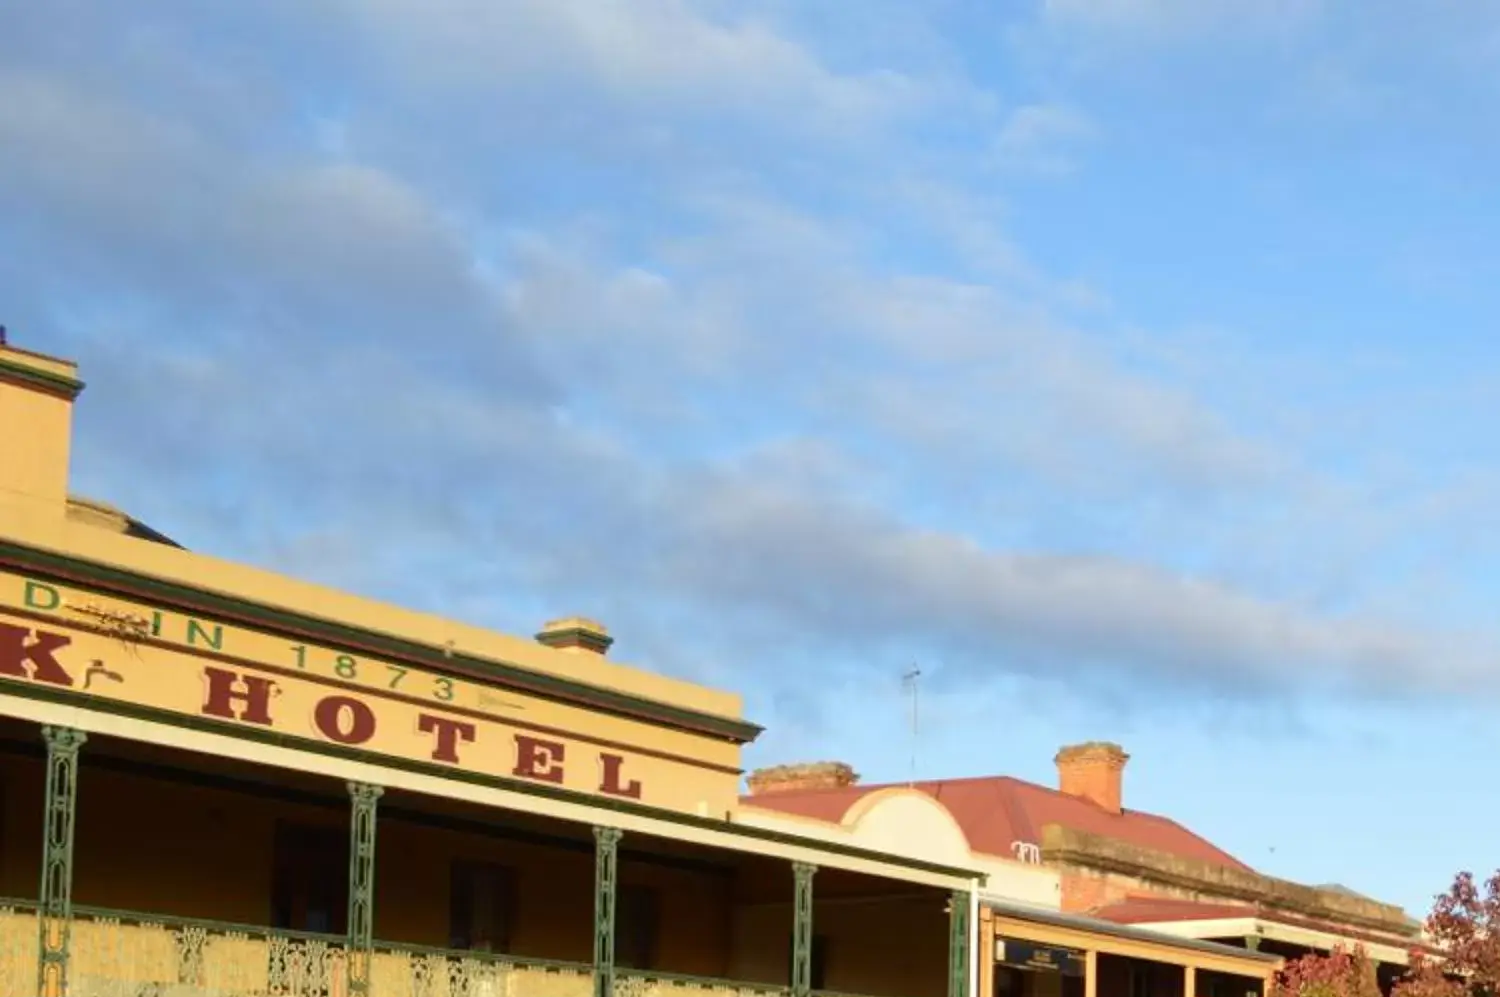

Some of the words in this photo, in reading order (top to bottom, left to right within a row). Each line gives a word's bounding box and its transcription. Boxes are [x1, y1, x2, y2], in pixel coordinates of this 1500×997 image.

[0, 621, 74, 687] K
[201, 666, 642, 800] HOTEL
[152, 611, 223, 650] IN
[291, 645, 454, 701] 1873
